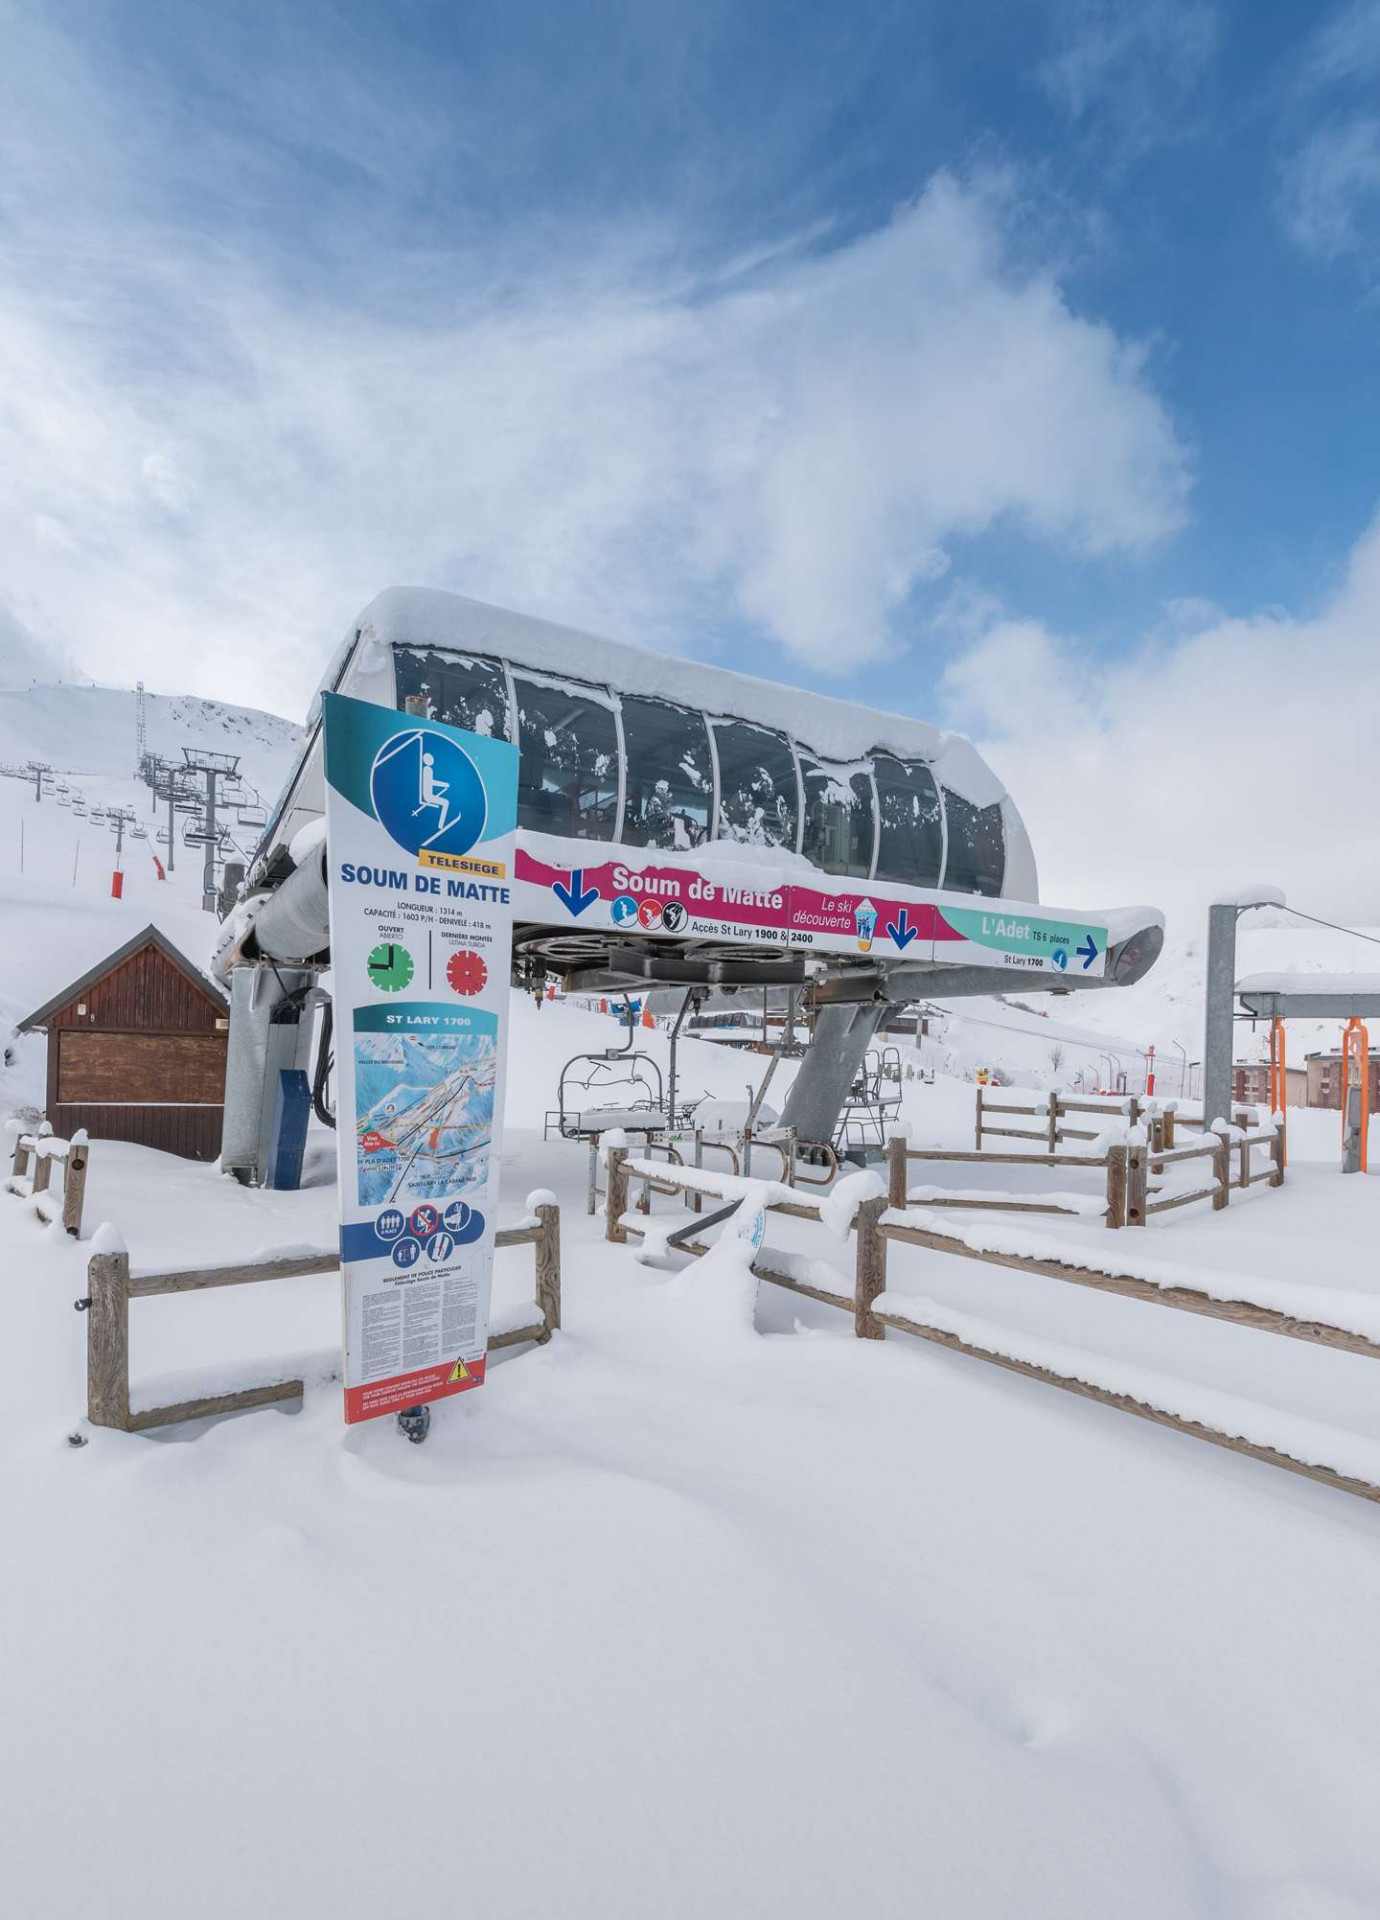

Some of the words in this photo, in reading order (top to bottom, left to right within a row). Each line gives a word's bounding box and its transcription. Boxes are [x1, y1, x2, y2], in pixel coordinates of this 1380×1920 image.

[428, 856, 499, 875] TELESIEGE
[341, 863, 407, 891] SOUM
[415, 874, 440, 895] DE
[447, 880, 510, 904] MATTE
[612, 866, 681, 897] Soum
[688, 878, 715, 900] de
[722, 887, 783, 910] Matte
[397, 902, 434, 914] LONGUEUR
[440, 907, 455, 916] 1314
[822, 896, 836, 911] Le
[837, 899, 852, 914] ski
[364, 908, 396, 919] CAPACITÉ
[403, 912, 419, 922] 1603
[421, 916, 434, 924] P/H
[472, 920, 484, 929] 418
[793, 910, 851, 929] découverte
[378, 925, 404, 934] OUVERT
[379, 932, 403, 940] ABIERTO
[441, 931, 468, 940] DERNIÈRE
[470, 934, 493, 942] MONTÉE
[692, 921, 718, 934] Accès
[720, 923, 732, 935] St
[734, 924, 752, 938] Lary
[755, 929, 778, 940] 1900
[780, 932, 788, 940] &
[791, 932, 814, 943] 2400
[982, 916, 1030, 940] L'Adet
[1032, 931, 1041, 940] TS
[1042, 932, 1048, 942] 6
[1050, 934, 1070, 944] places
[1004, 954, 1012, 964] St
[1012, 956, 1026, 966] Lary
[1027, 958, 1044, 966] 1700
[386, 1015, 403, 1024] ST
[406, 1016, 440, 1025] LARY
[444, 1018, 472, 1026] 1700
